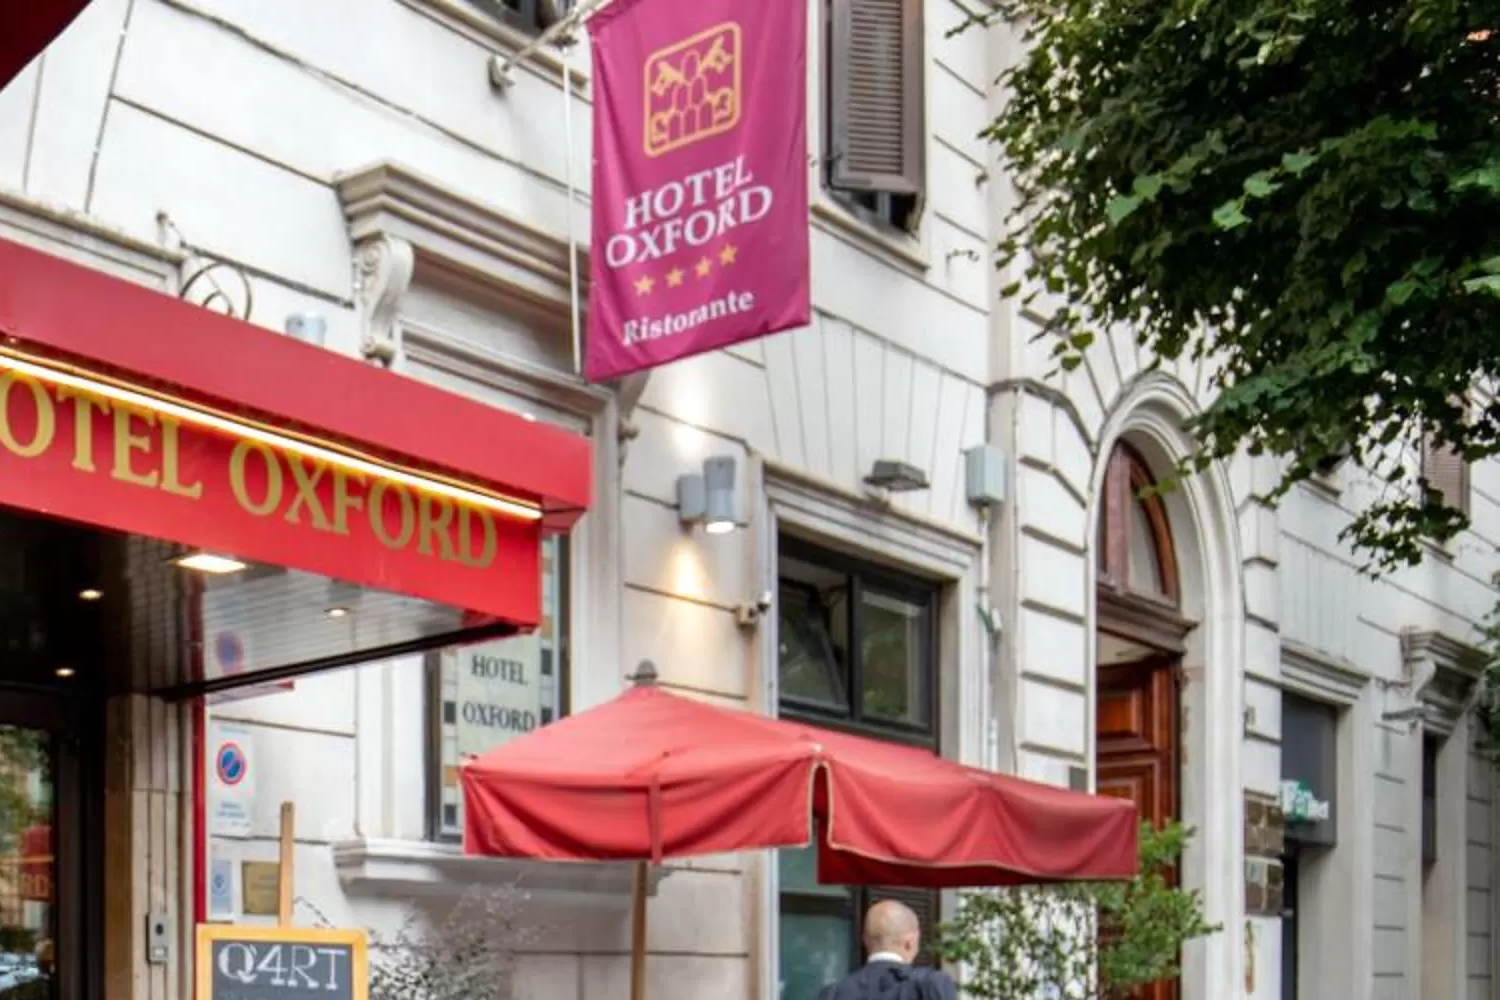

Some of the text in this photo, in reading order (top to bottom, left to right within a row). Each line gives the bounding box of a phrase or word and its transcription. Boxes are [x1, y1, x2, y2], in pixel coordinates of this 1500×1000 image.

[623, 157, 753, 230] HOTEL
[605, 185, 774, 269] OXFORD
[621, 288, 755, 347] Ristorante
[229, 438, 498, 571] OXFORD
[471, 653, 529, 686] HOTEL
[462, 701, 536, 733] OXFORD
